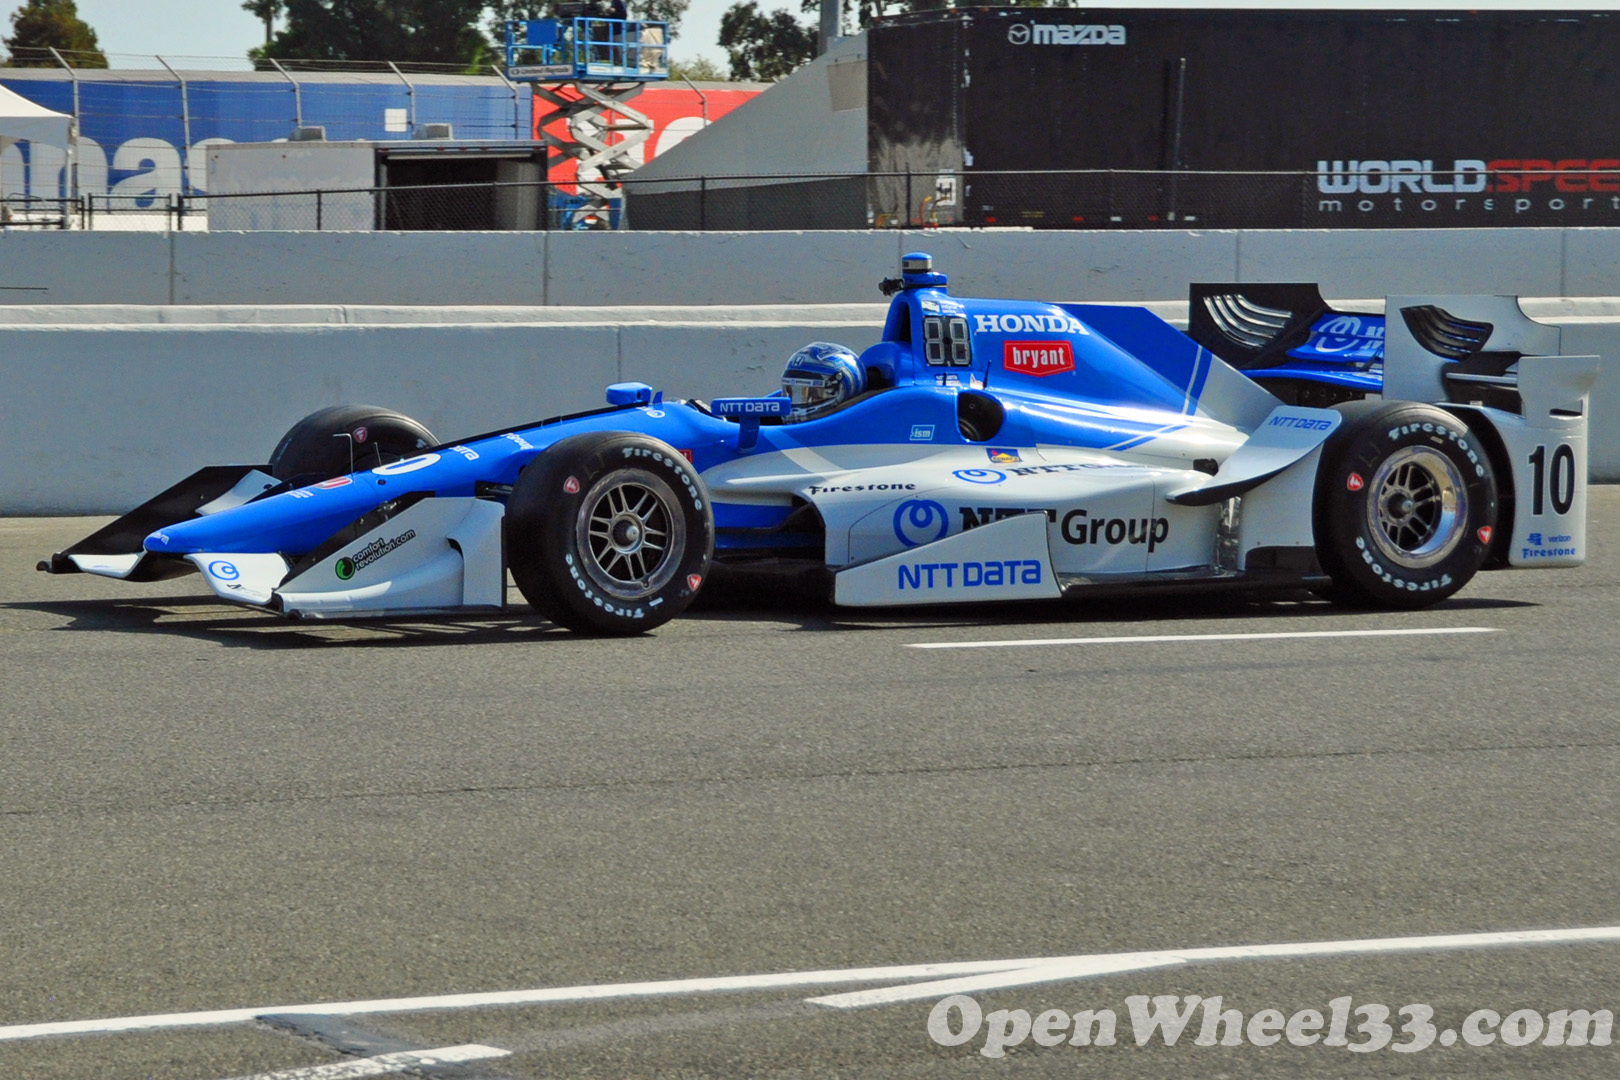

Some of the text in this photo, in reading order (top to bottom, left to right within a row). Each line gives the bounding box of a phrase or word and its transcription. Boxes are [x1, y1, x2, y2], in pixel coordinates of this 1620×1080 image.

[1033, 24, 1126, 45] mazda
[1317, 160, 1486, 194] WORLD
[973, 314, 1090, 336] HONDA
[1012, 346, 1066, 369] bryant
[719, 402, 744, 413] NTT
[914, 428, 931, 438] ism
[1268, 416, 1299, 427] NTT
[1388, 422, 1485, 477] Firestone
[621, 447, 703, 512] Firestone
[808, 483, 916, 496] Firestone
[1528, 444, 1576, 516] 10
[1060, 509, 1169, 553] Group
[1548, 534, 1572, 543] verizon
[352, 537, 386, 563] comfort
[355, 529, 416, 571] revolution.com
[1522, 548, 1576, 559] Firestone
[898, 562, 958, 590] NTT
[1355, 536, 1453, 591] Firestone
[565, 553, 645, 619] Firestone
